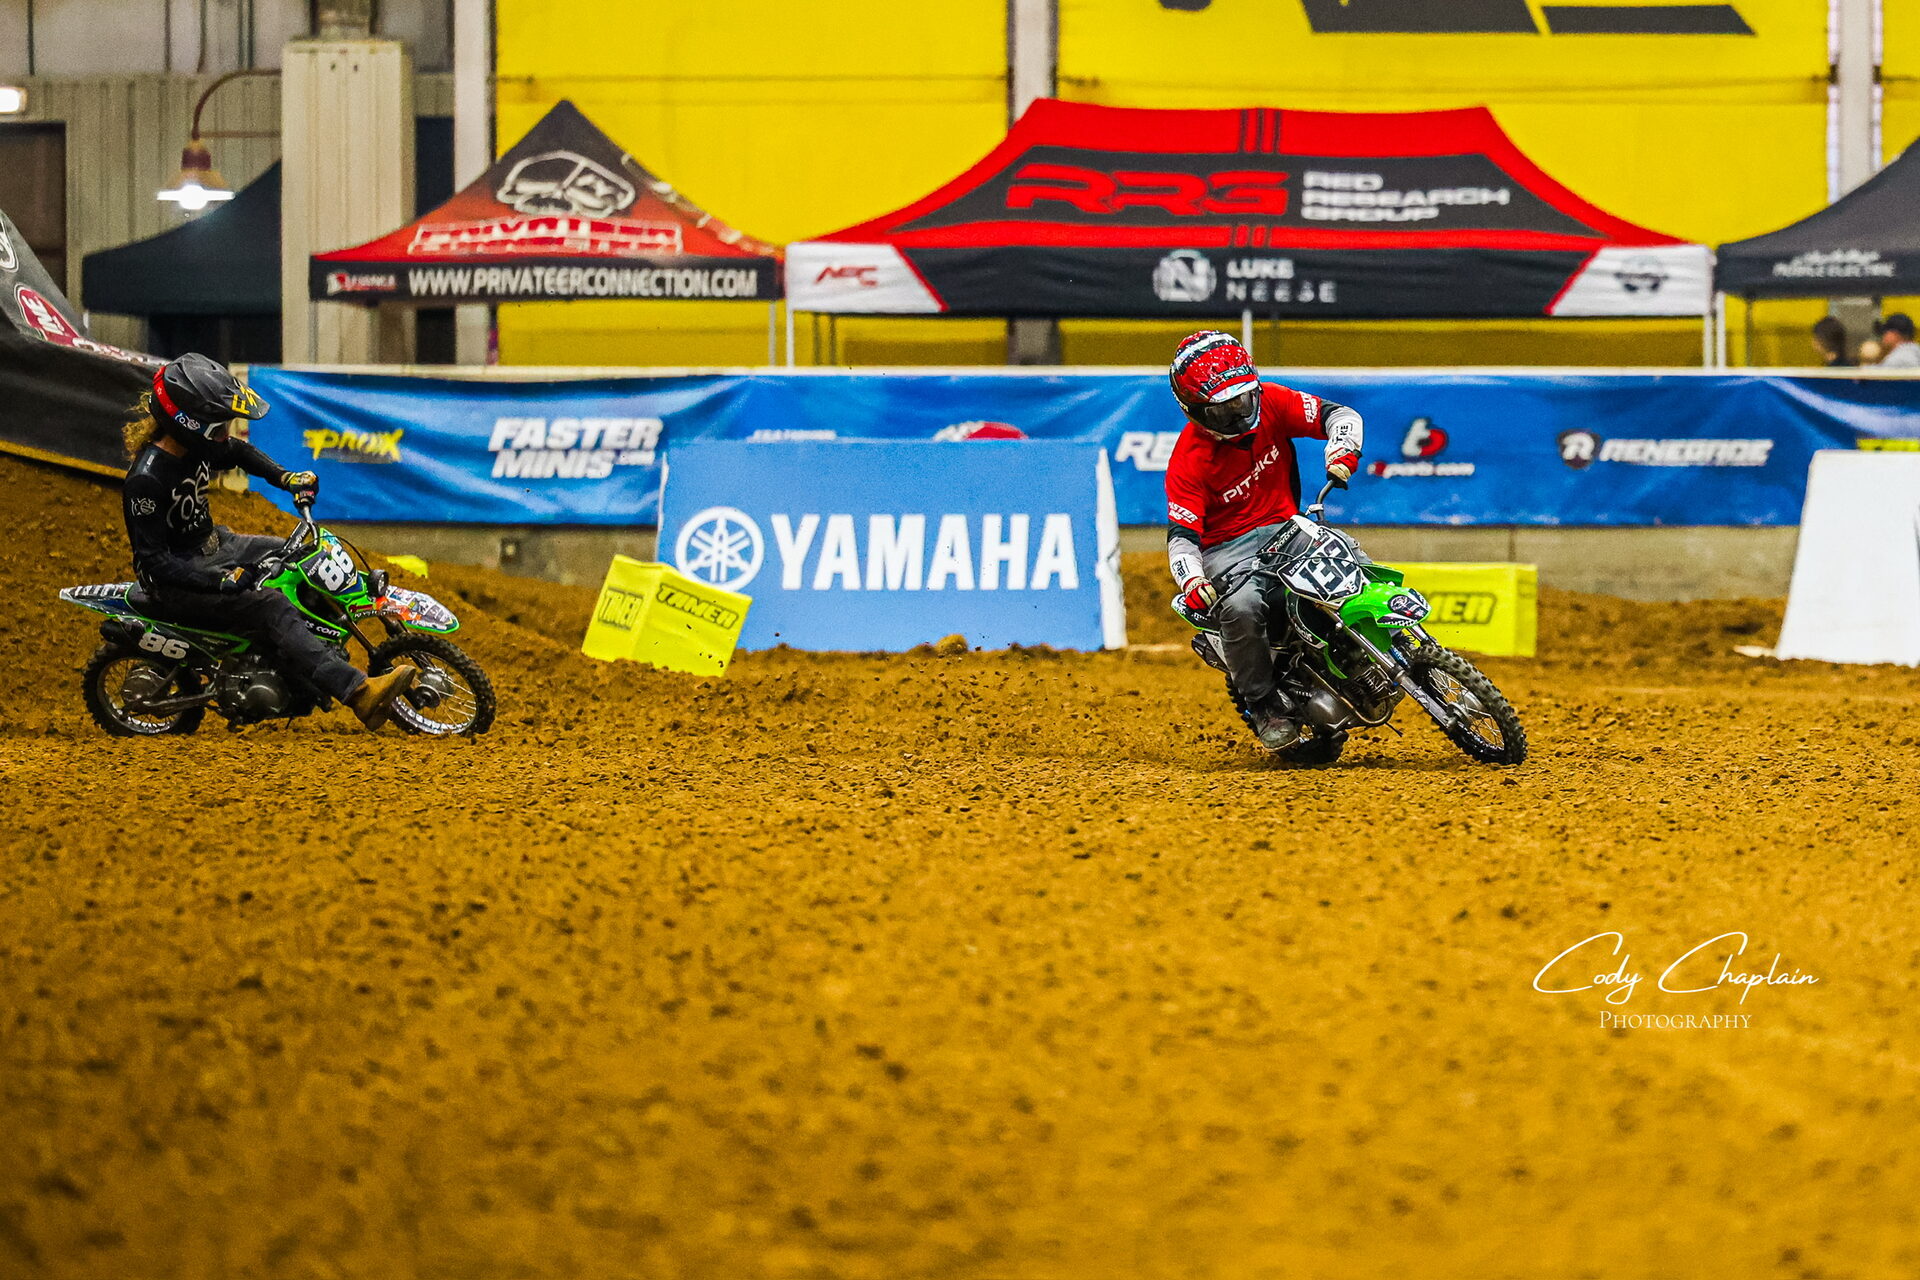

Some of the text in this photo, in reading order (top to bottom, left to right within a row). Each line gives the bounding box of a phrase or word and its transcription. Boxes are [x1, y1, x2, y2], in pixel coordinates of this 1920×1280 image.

[1006, 164, 1290, 216] RRG
[1303, 171, 1383, 191] RED
[1302, 187, 1511, 207] RESEARCH
[1301, 205, 1440, 222] GROUP
[408, 268, 758, 298] WWW.PRIVATEERCONNECTION.COM
[1226, 258, 1295, 280] LUKE
[488, 417, 664, 451] FASTER
[491, 450, 615, 479] MINIS
[1115, 431, 1181, 471] RE
[1599, 438, 1774, 467] RENEGADE
[771, 513, 1079, 590] YAMAHA
[318, 544, 354, 591] 86
[656, 582, 740, 630] TAMER
[138, 632, 190, 659] 86
